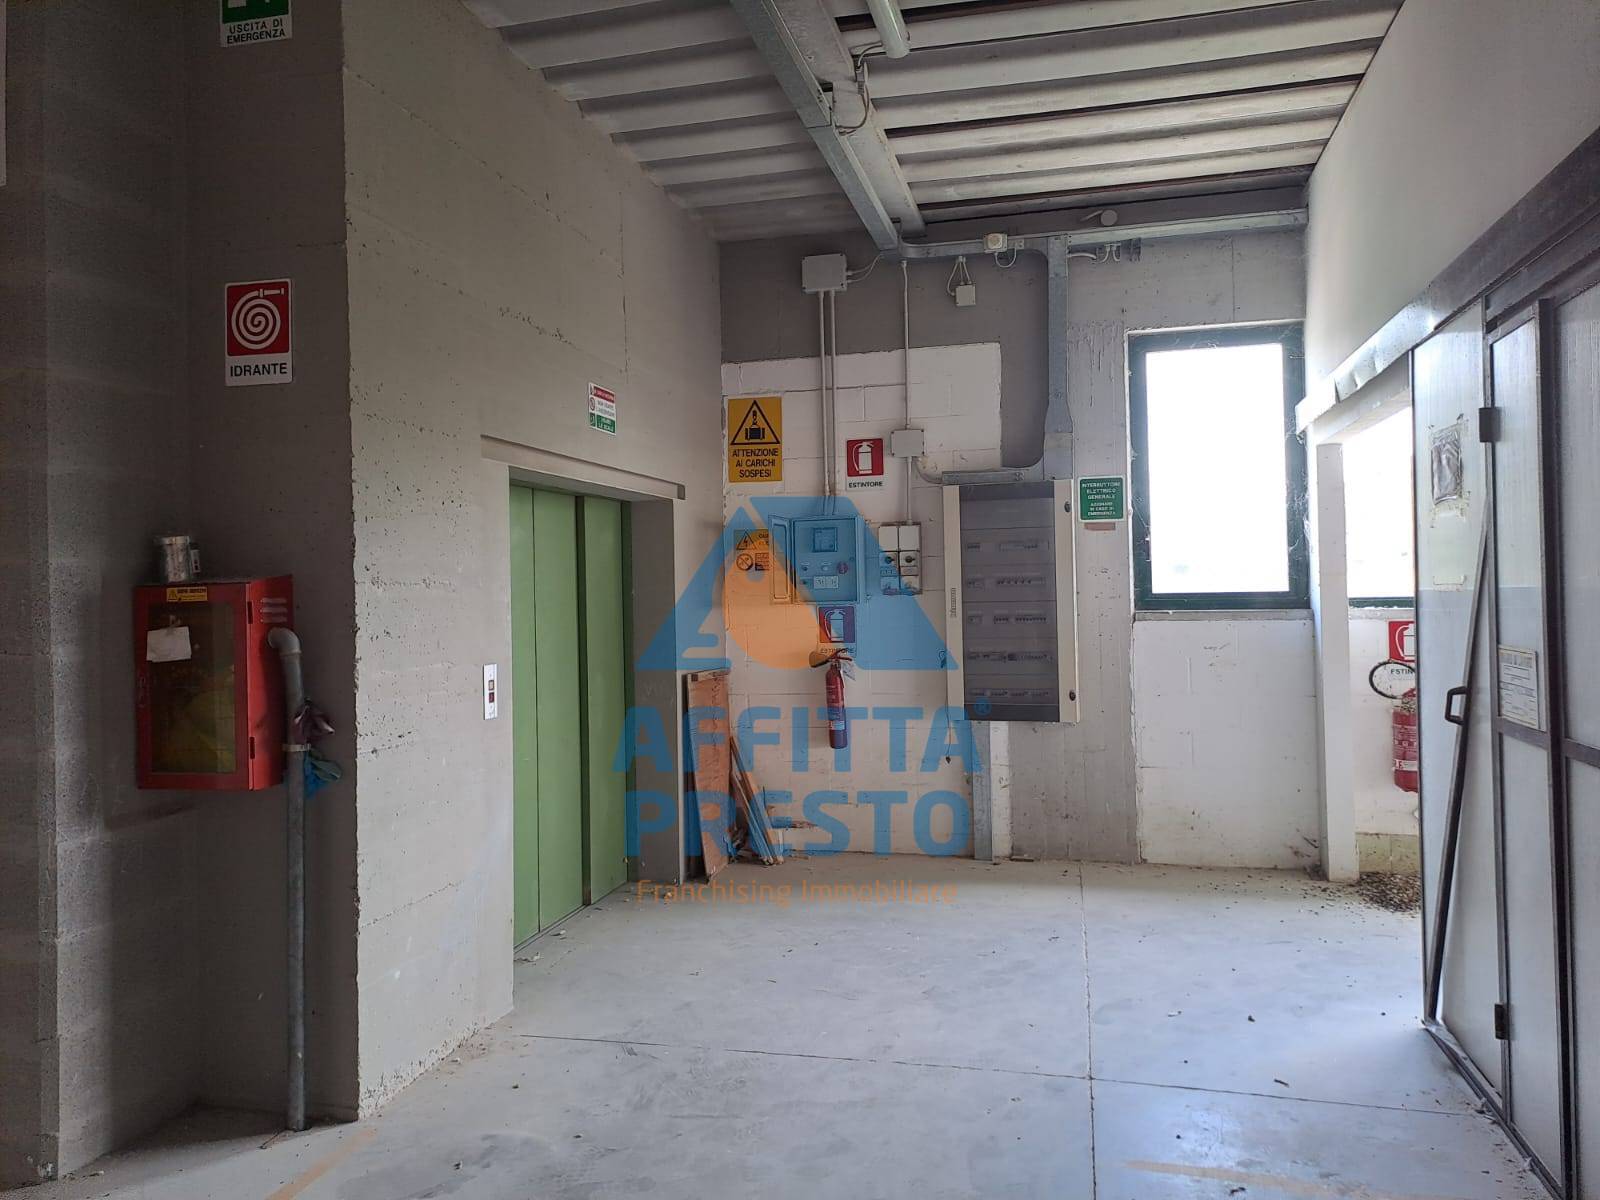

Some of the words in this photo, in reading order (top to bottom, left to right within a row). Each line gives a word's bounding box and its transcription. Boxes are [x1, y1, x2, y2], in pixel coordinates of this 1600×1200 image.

[229, 21, 267, 34] USCITA
[273, 18, 283, 28] DI
[226, 28, 286, 44] EMERGENZA
[230, 362, 288, 377] IDRANTE
[732, 448, 779, 457] ATTENZIONE
[736, 459, 743, 467] AI
[745, 458, 776, 467] CARICHI
[739, 469, 772, 478] SOSPESI
